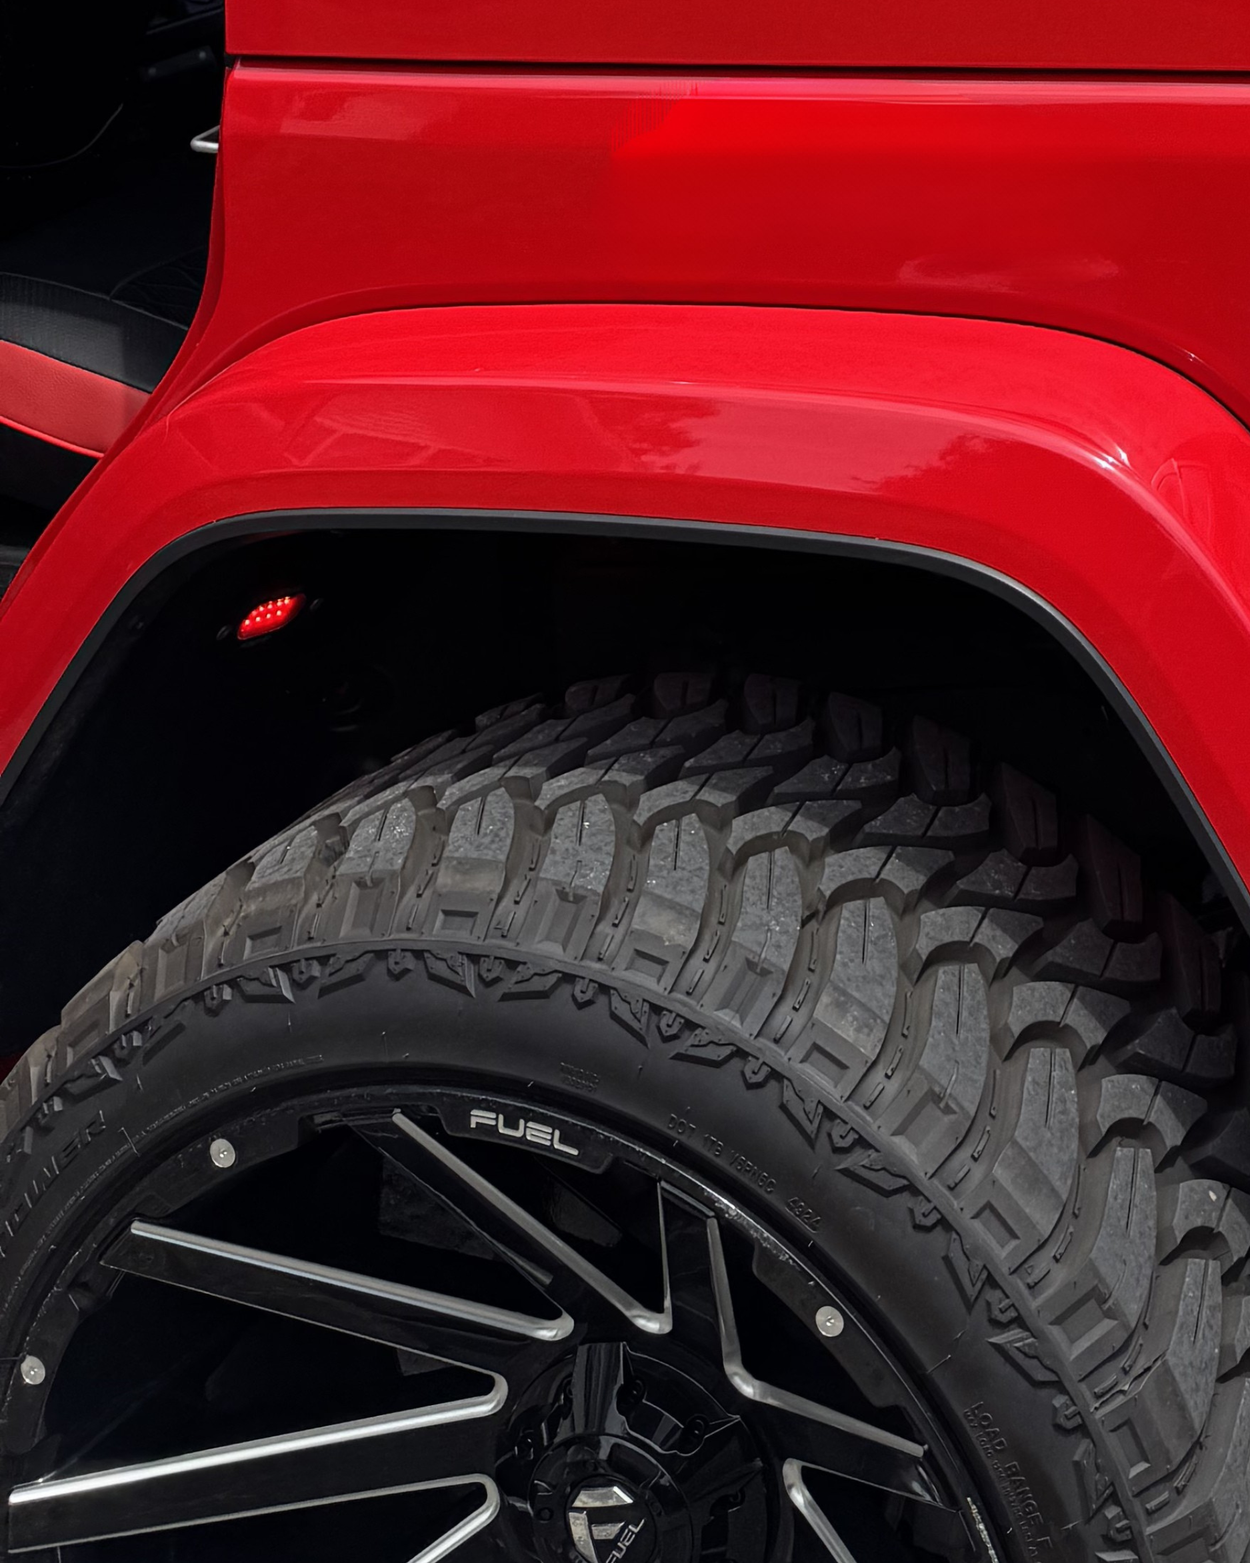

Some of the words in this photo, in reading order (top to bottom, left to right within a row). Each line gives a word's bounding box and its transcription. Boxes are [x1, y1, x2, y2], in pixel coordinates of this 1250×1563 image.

[470, 1109, 579, 1156] FUEL
[667, 1113, 697, 1139] DOT
[970, 1401, 1008, 1450] LOAD
[1004, 1461, 1044, 1525] RANGE
